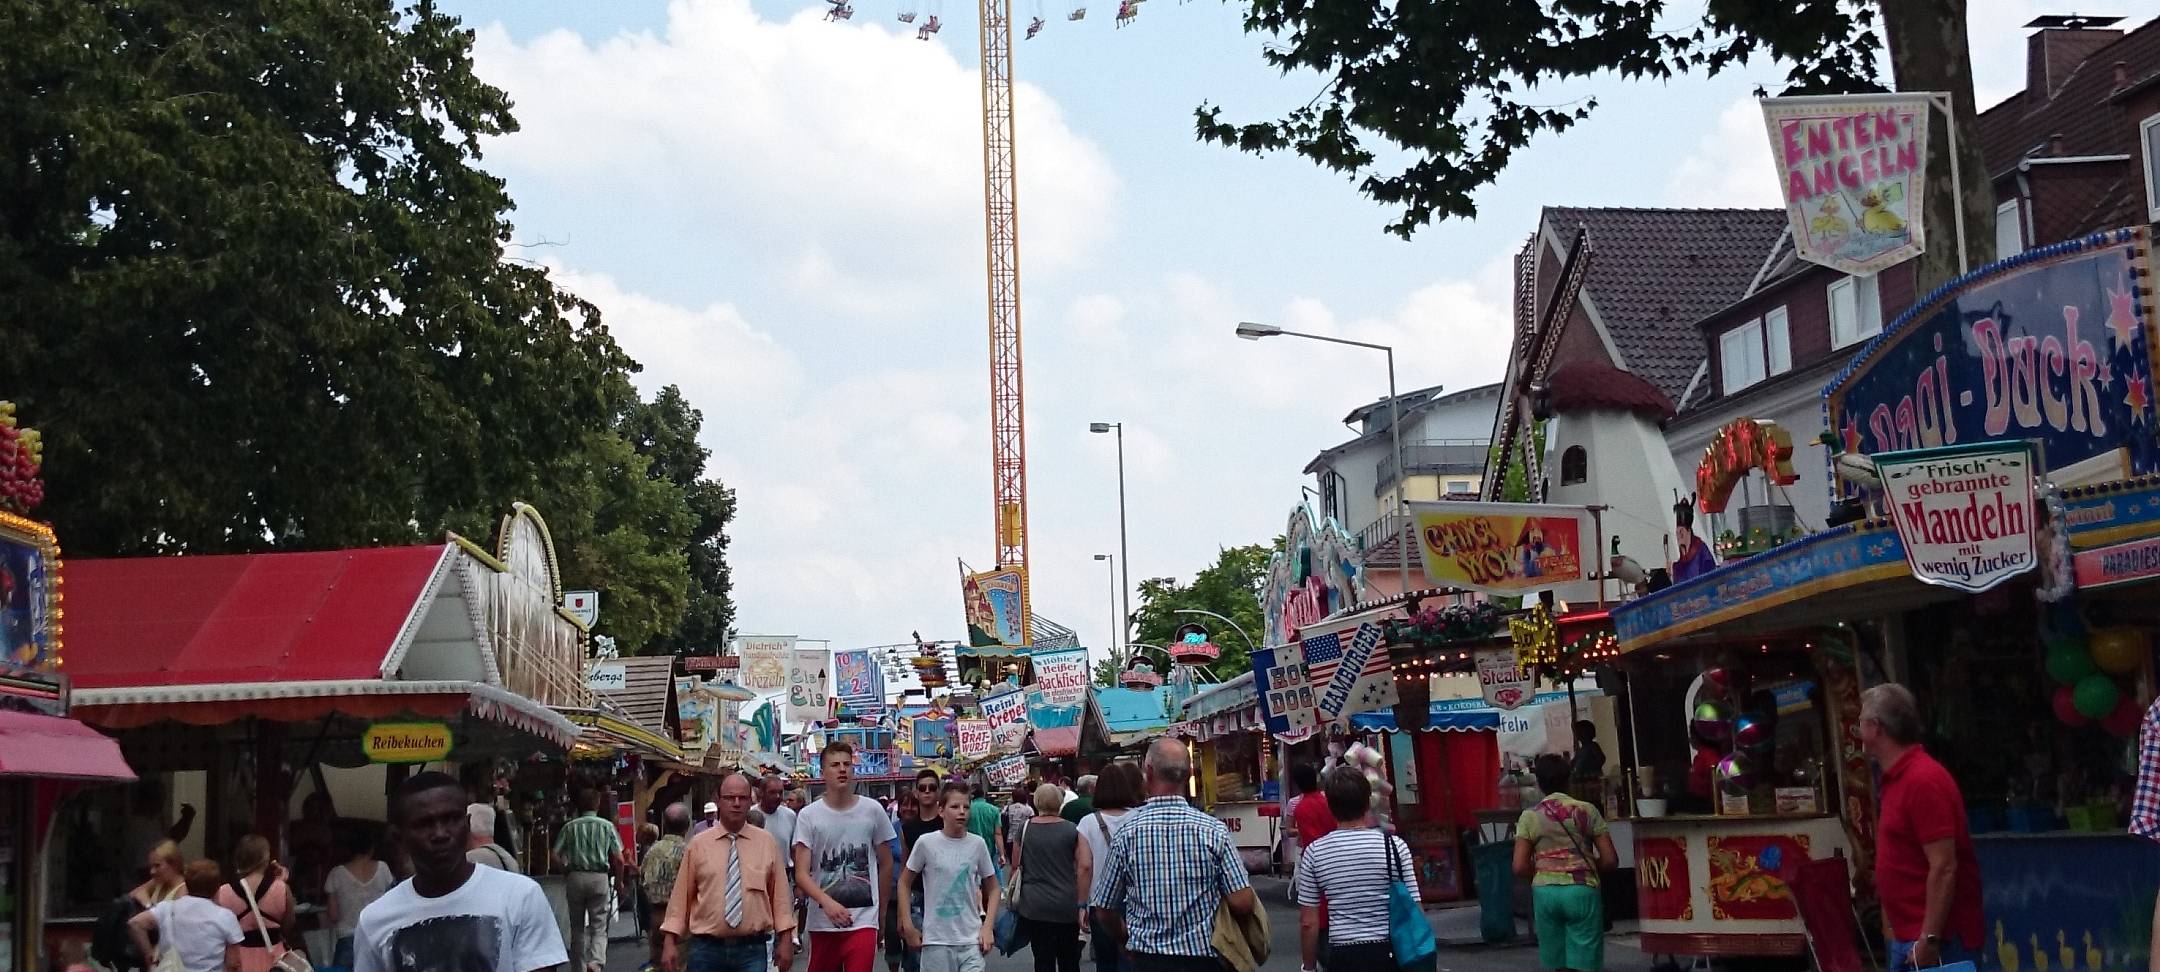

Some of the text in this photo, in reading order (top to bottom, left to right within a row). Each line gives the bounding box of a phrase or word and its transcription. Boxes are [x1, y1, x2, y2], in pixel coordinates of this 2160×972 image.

[1781, 108, 1911, 168] ENTEN-
[1788, 139, 1919, 204] ANGELN
[1926, 460, 1987, 478] Frisch
[1908, 474, 2011, 499] gebrannte
[1901, 492, 2026, 544] Mandeln
[1424, 517, 1498, 556] CHINA
[1958, 544, 1982, 556] mit
[2103, 544, 2160, 577] PARADIES
[1456, 544, 1522, 584] WOK
[1922, 551, 2026, 581] wenig Zucker
[744, 672, 786, 688] Brezeln
[790, 668, 817, 683] Eis
[1037, 671, 1086, 690] Backfisch
[1043, 663, 1078, 674] Heißer
[1270, 663, 1312, 690] HOT
[1319, 622, 1382, 717] HAMBURGER
[1482, 666, 1530, 685] Steaks
[790, 685, 826, 707] Eis
[1270, 686, 1313, 715] DOG
[989, 703, 1026, 730] Crêpes
[373, 735, 445, 749] Reibekuchen
[962, 732, 990, 744] BRAT-
[962, 741, 990, 752] WURST
